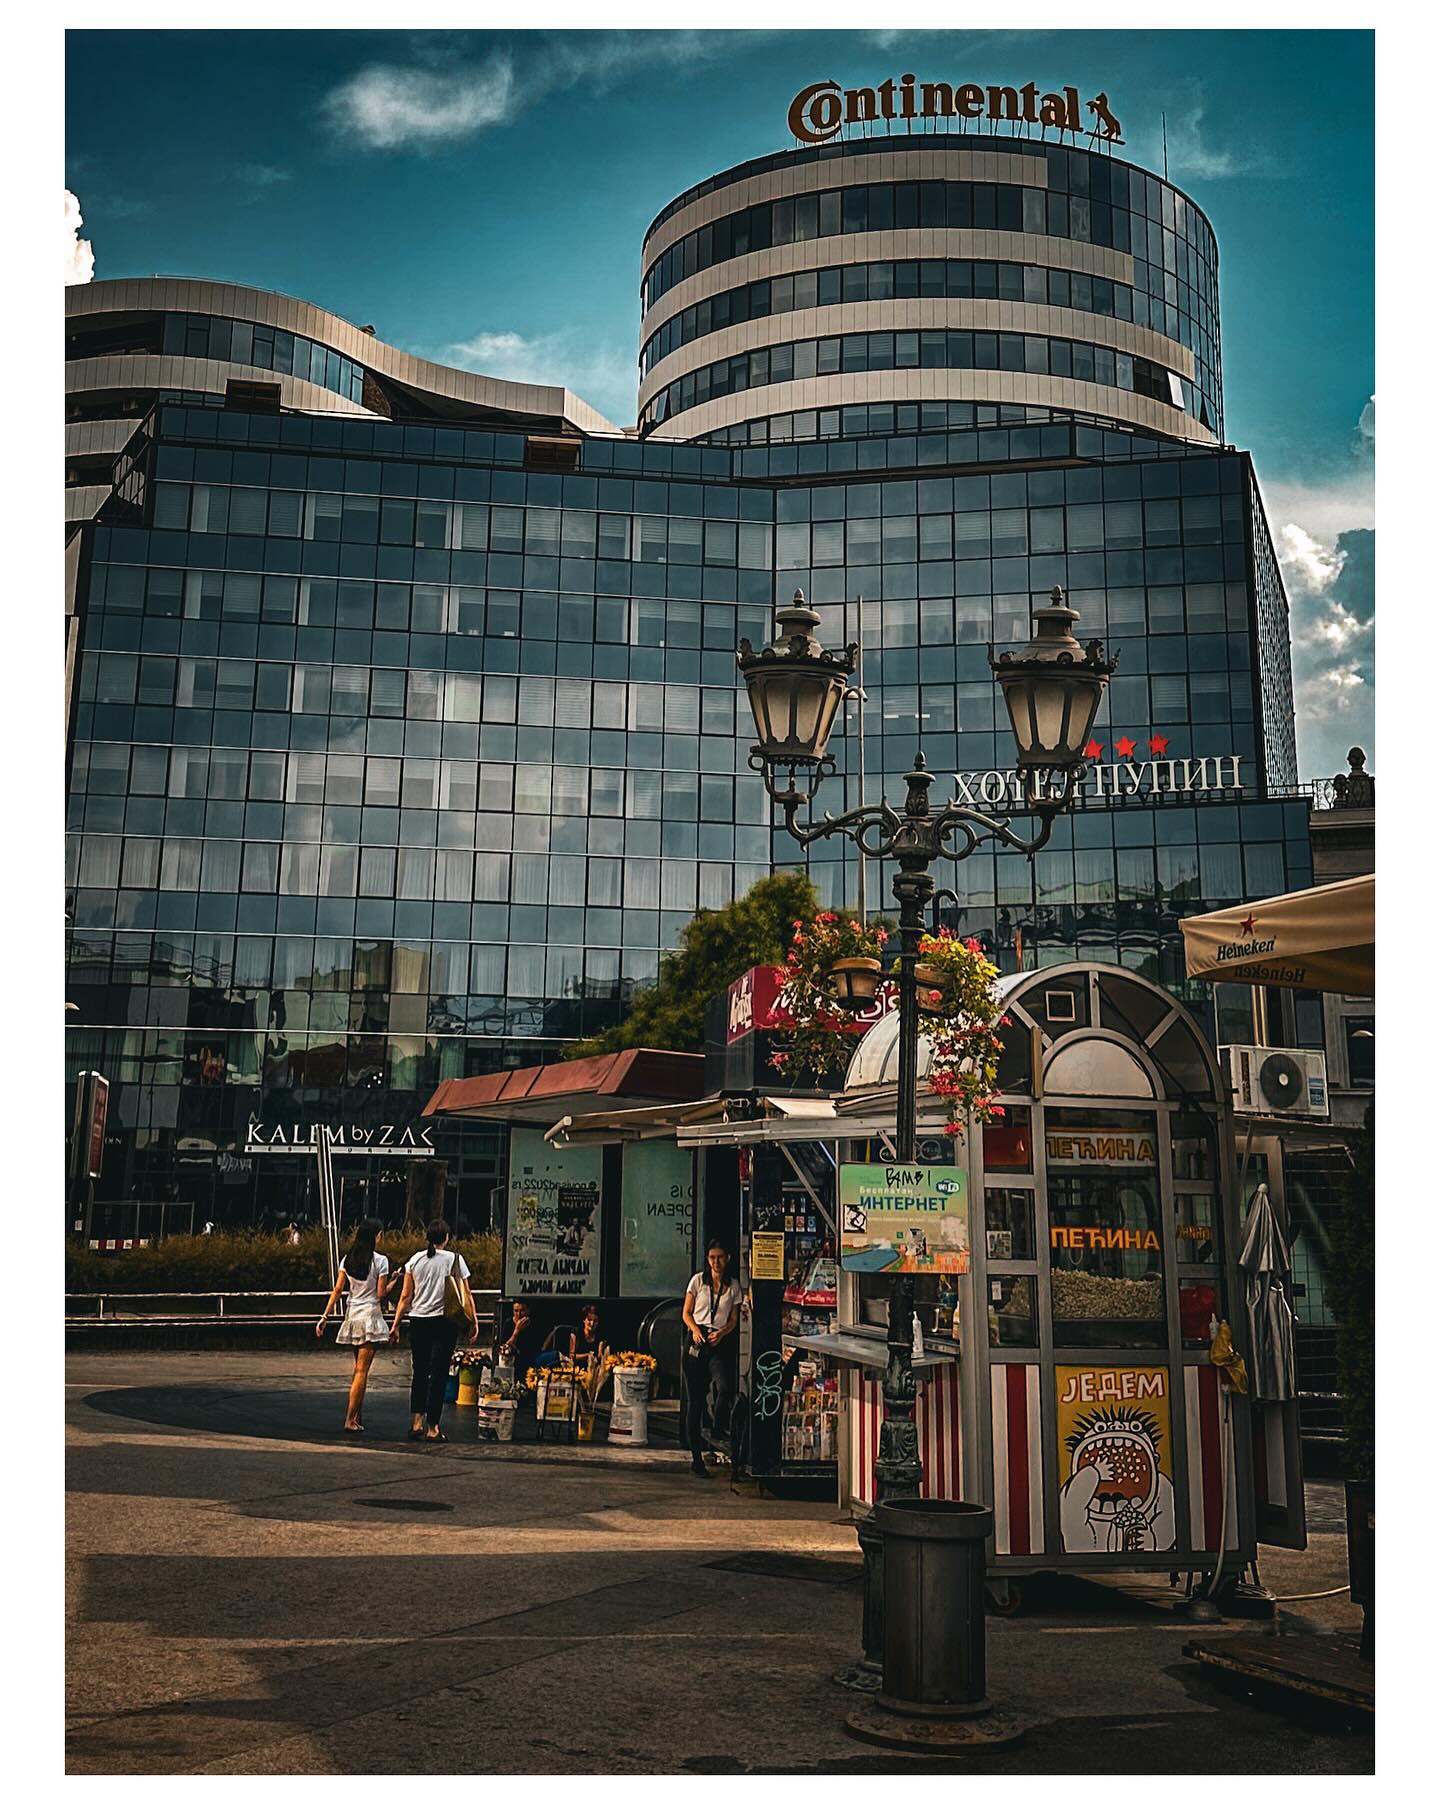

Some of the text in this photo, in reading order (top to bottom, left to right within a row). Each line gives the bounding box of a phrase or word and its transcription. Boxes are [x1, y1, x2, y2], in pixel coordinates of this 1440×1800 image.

[788, 73, 1084, 143] Continental
[1093, 755, 1245, 797] ПУПИН
[1216, 937, 1276, 961] Heineken
[352, 1125, 374, 1145] by
[860, 1196, 948, 1211] ИНТЕРНЕТ
[1051, 1226, 1161, 1251] ПЕЋИНА
[1061, 1371, 1166, 1403] ЈЕДЕМ
